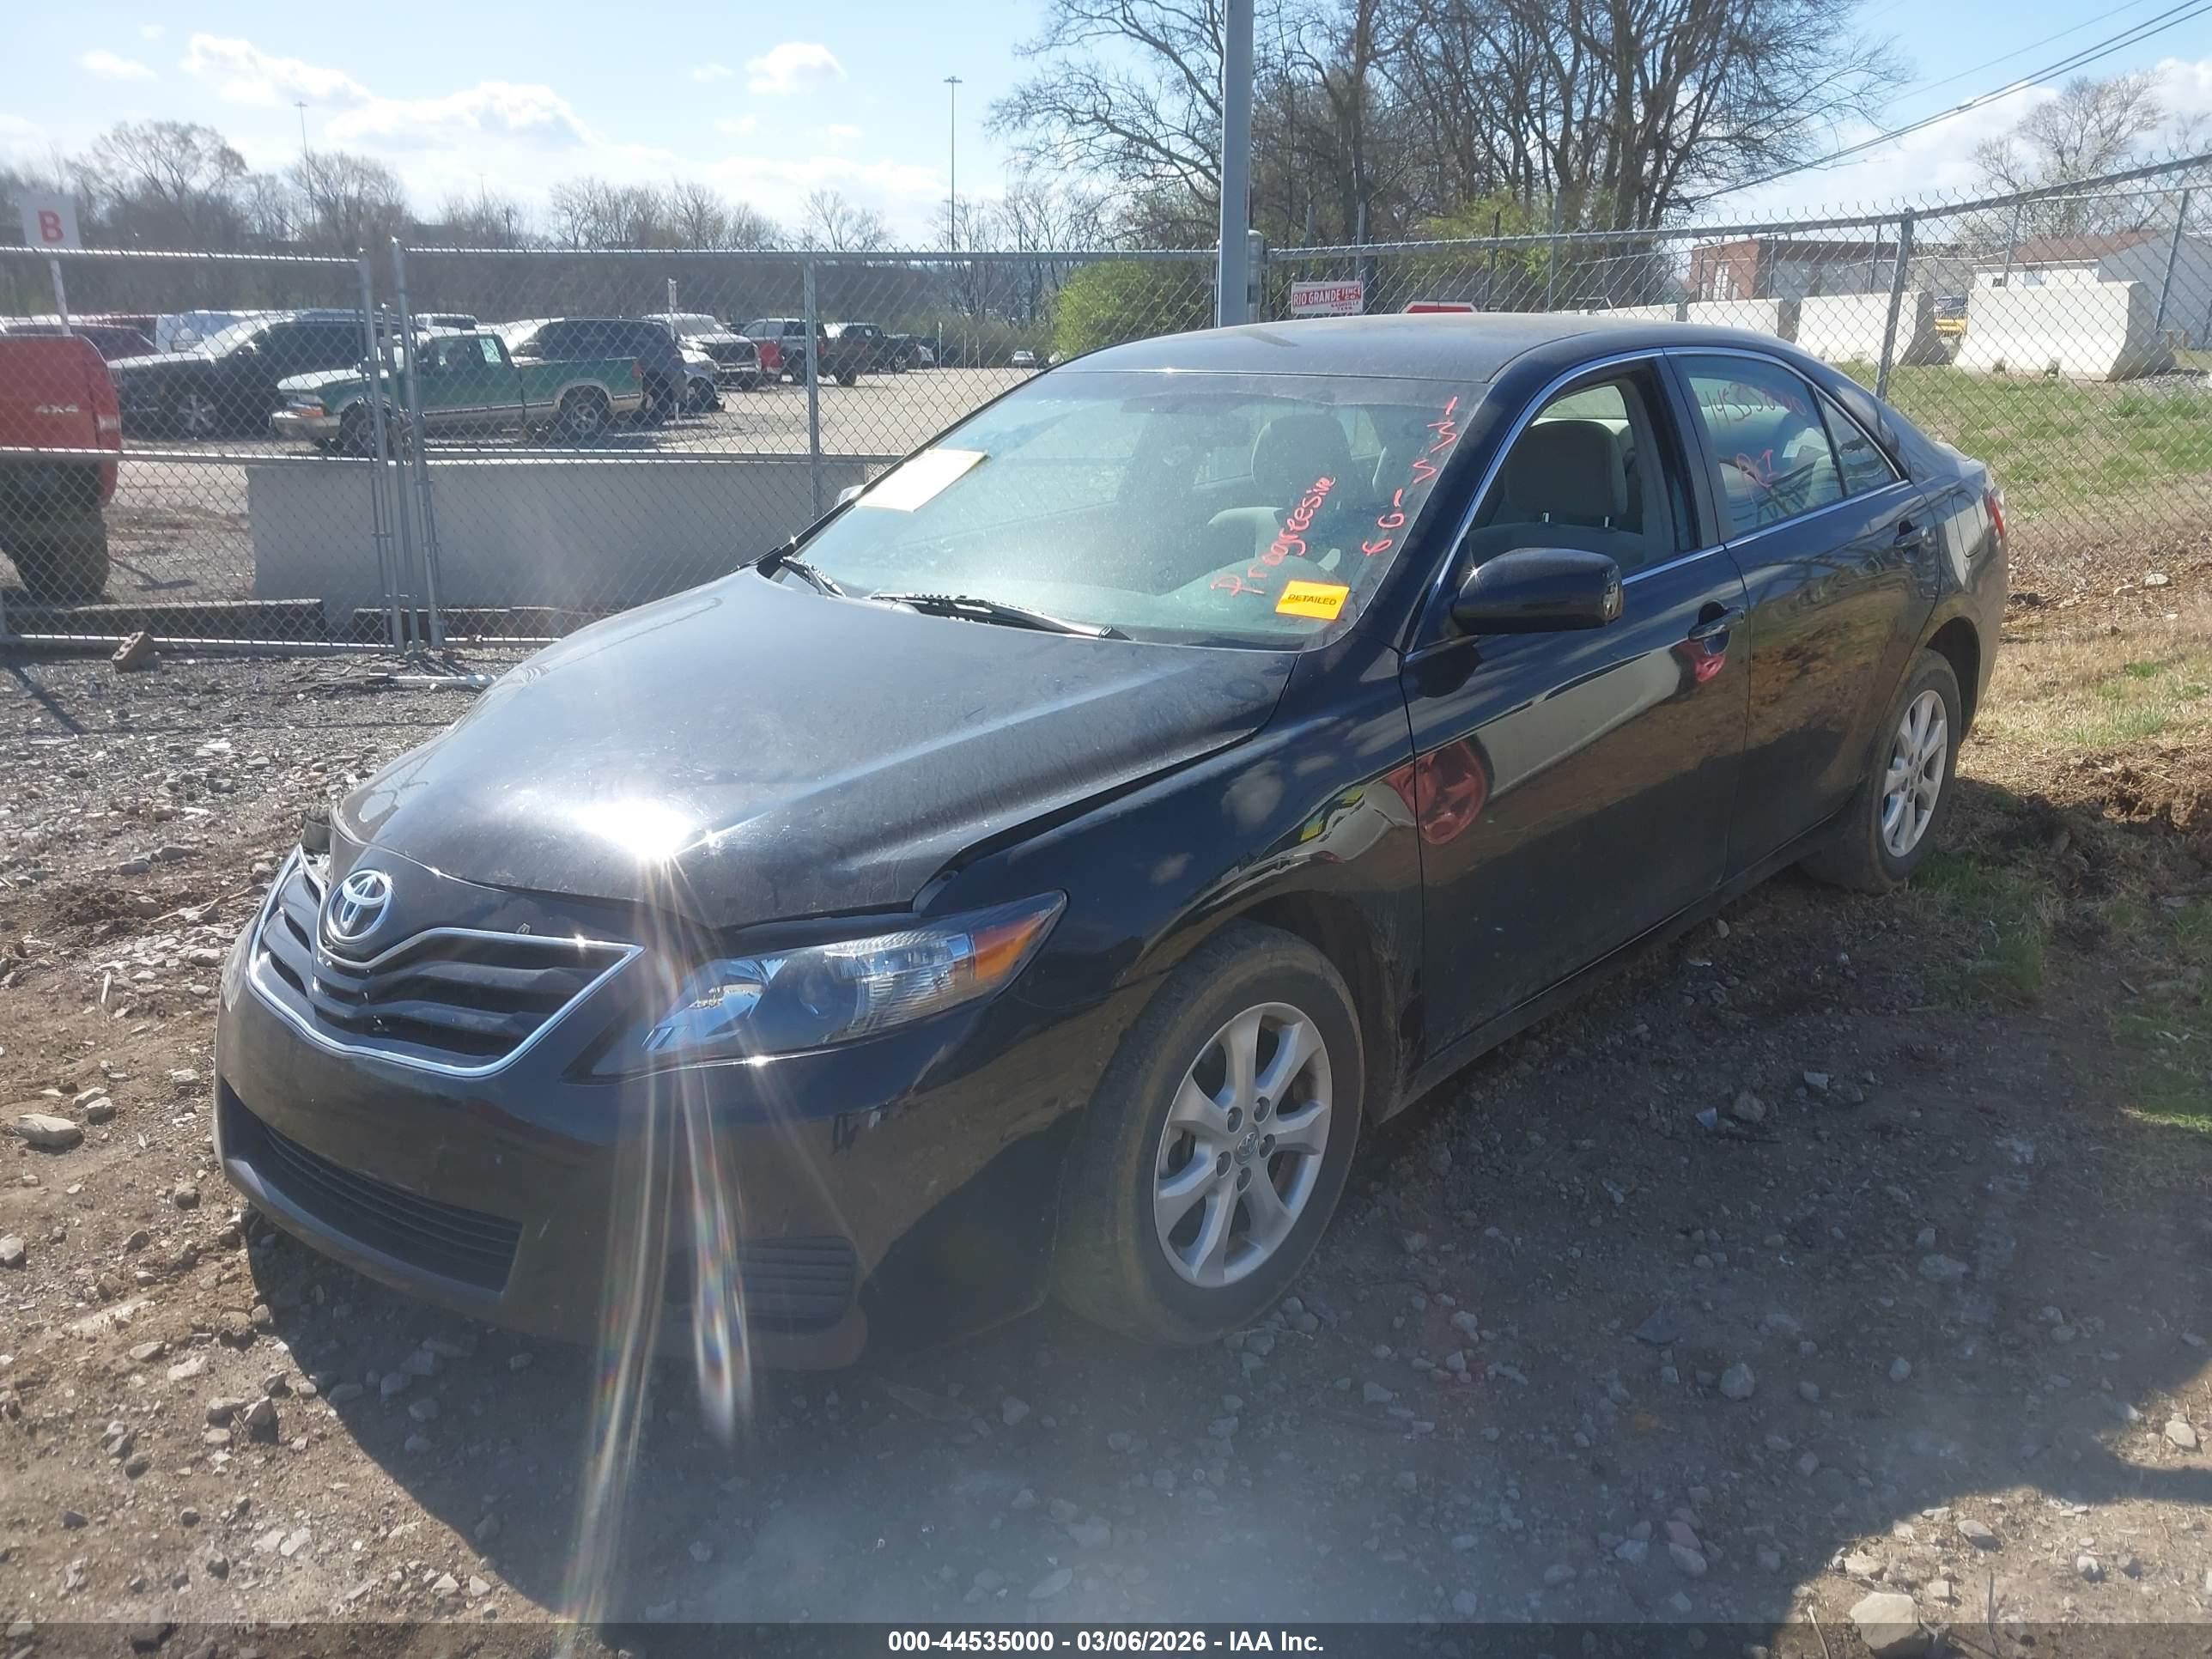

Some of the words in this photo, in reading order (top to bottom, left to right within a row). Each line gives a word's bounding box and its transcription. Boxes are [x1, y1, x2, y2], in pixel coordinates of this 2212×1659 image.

[38, 210, 64, 243] B
[1293, 293, 1308, 307] RIO
[1308, 289, 1341, 304] GRANDE
[1288, 593, 1337, 606] DETAILED
